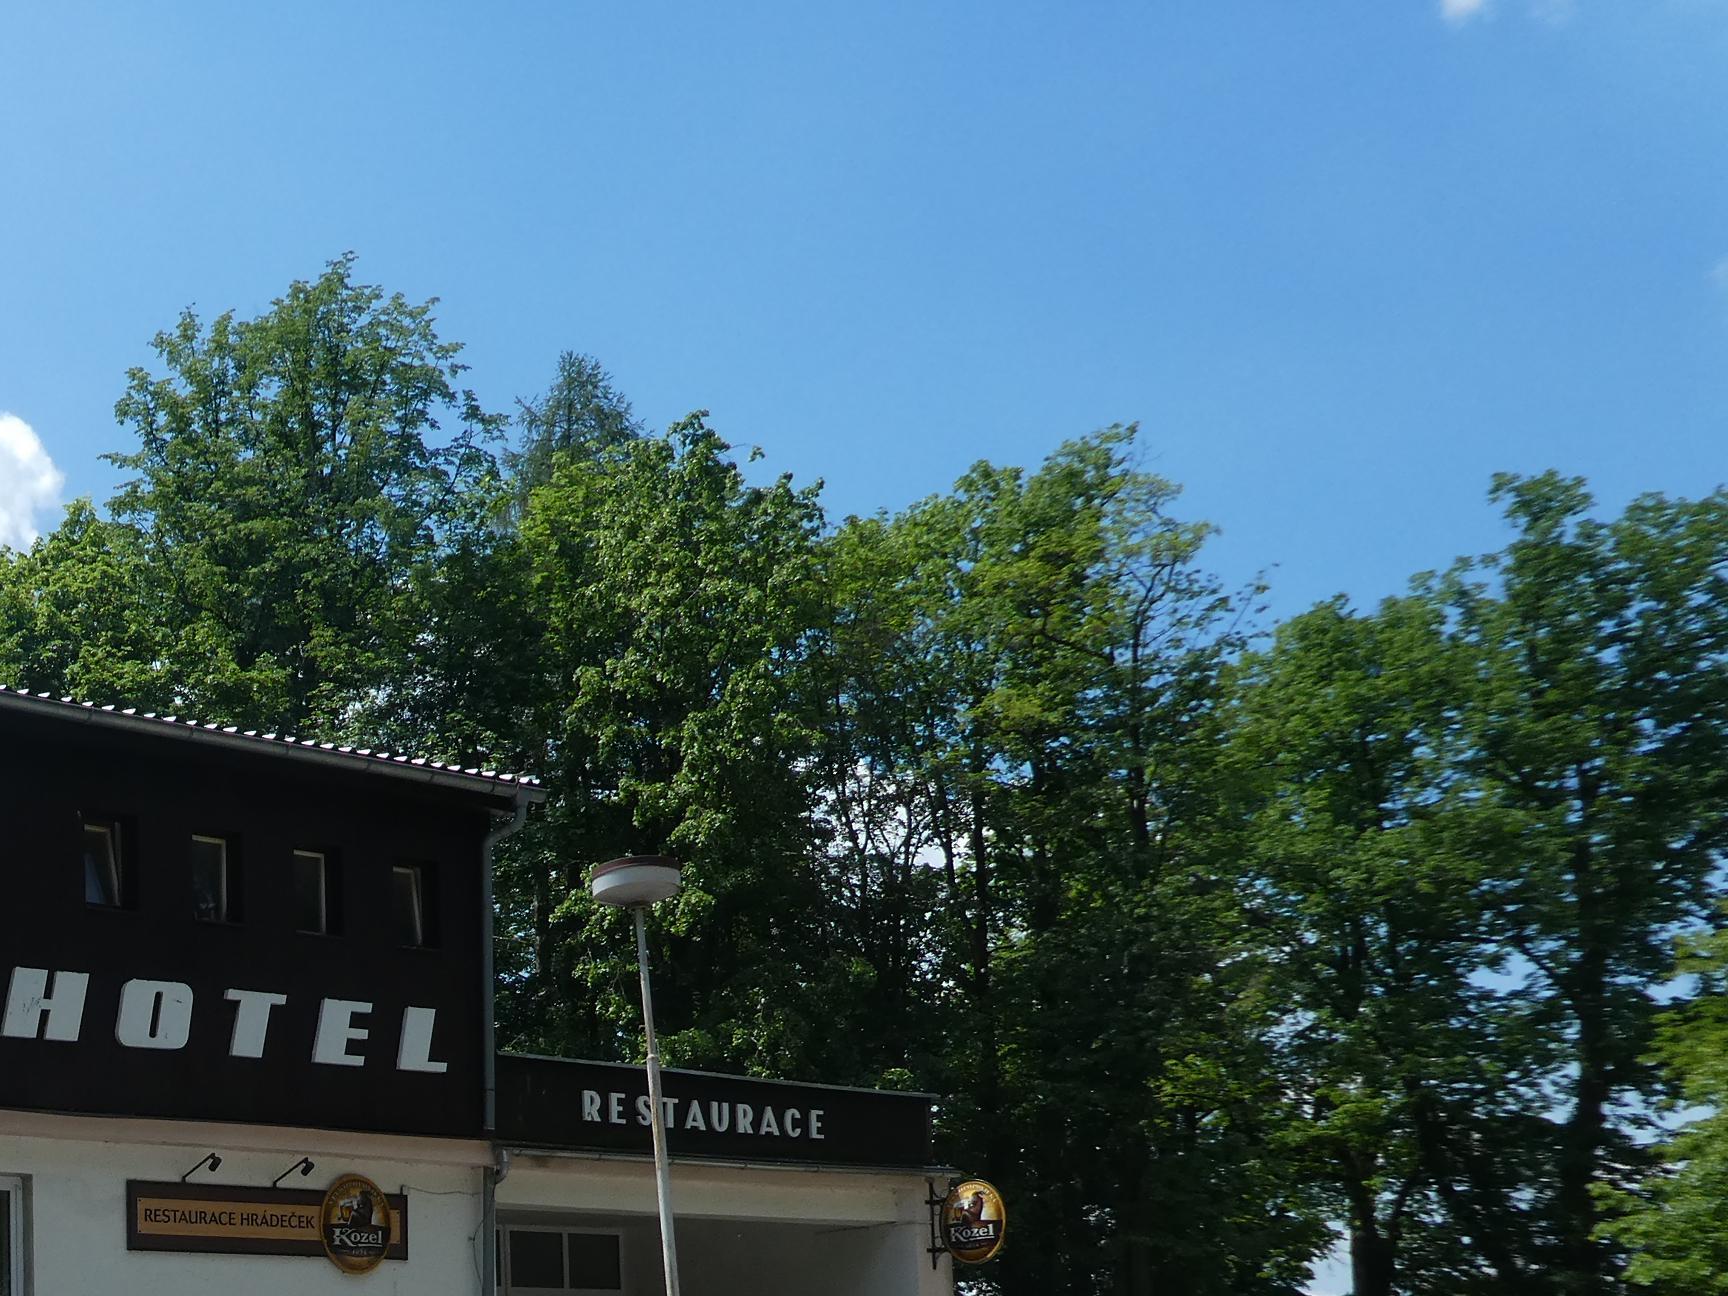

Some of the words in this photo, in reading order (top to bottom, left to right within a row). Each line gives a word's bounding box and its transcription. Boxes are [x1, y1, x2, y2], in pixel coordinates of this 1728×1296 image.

[0, 966, 448, 1073] HOTEL
[581, 1089, 825, 1140] RESTAURACE
[144, 1208, 236, 1226] RESTAURACE
[239, 1209, 315, 1230] HRÁDEČEK
[332, 1227, 383, 1247] Kozel
[949, 1224, 996, 1242] Kozel
